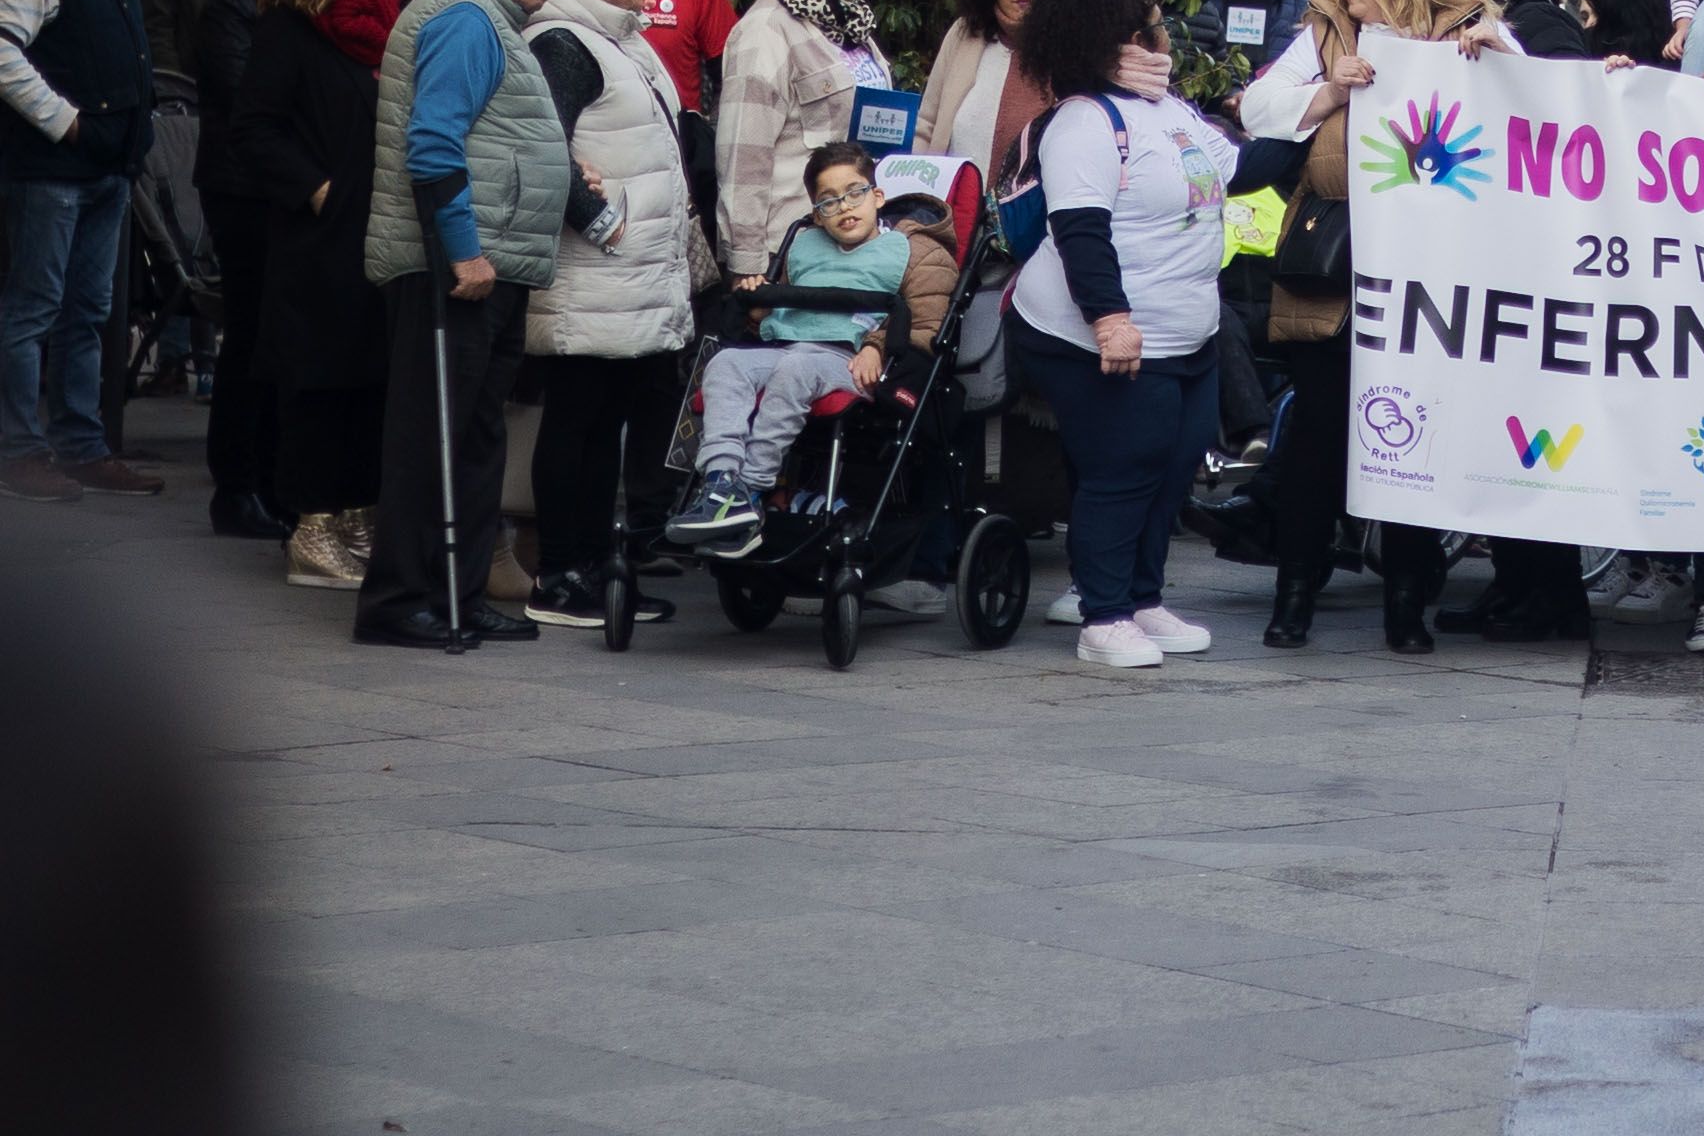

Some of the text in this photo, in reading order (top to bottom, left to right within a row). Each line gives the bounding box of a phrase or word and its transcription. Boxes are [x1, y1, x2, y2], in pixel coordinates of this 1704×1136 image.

[862, 125, 904, 136] UNIPER
[1507, 115, 1606, 202] NO
[884, 159, 941, 190] UNIPER
[1572, 235, 1630, 279] 28
[1652, 237, 1681, 279] F
[1371, 447, 1400, 462] Rett
[1390, 467, 1435, 483] Española
